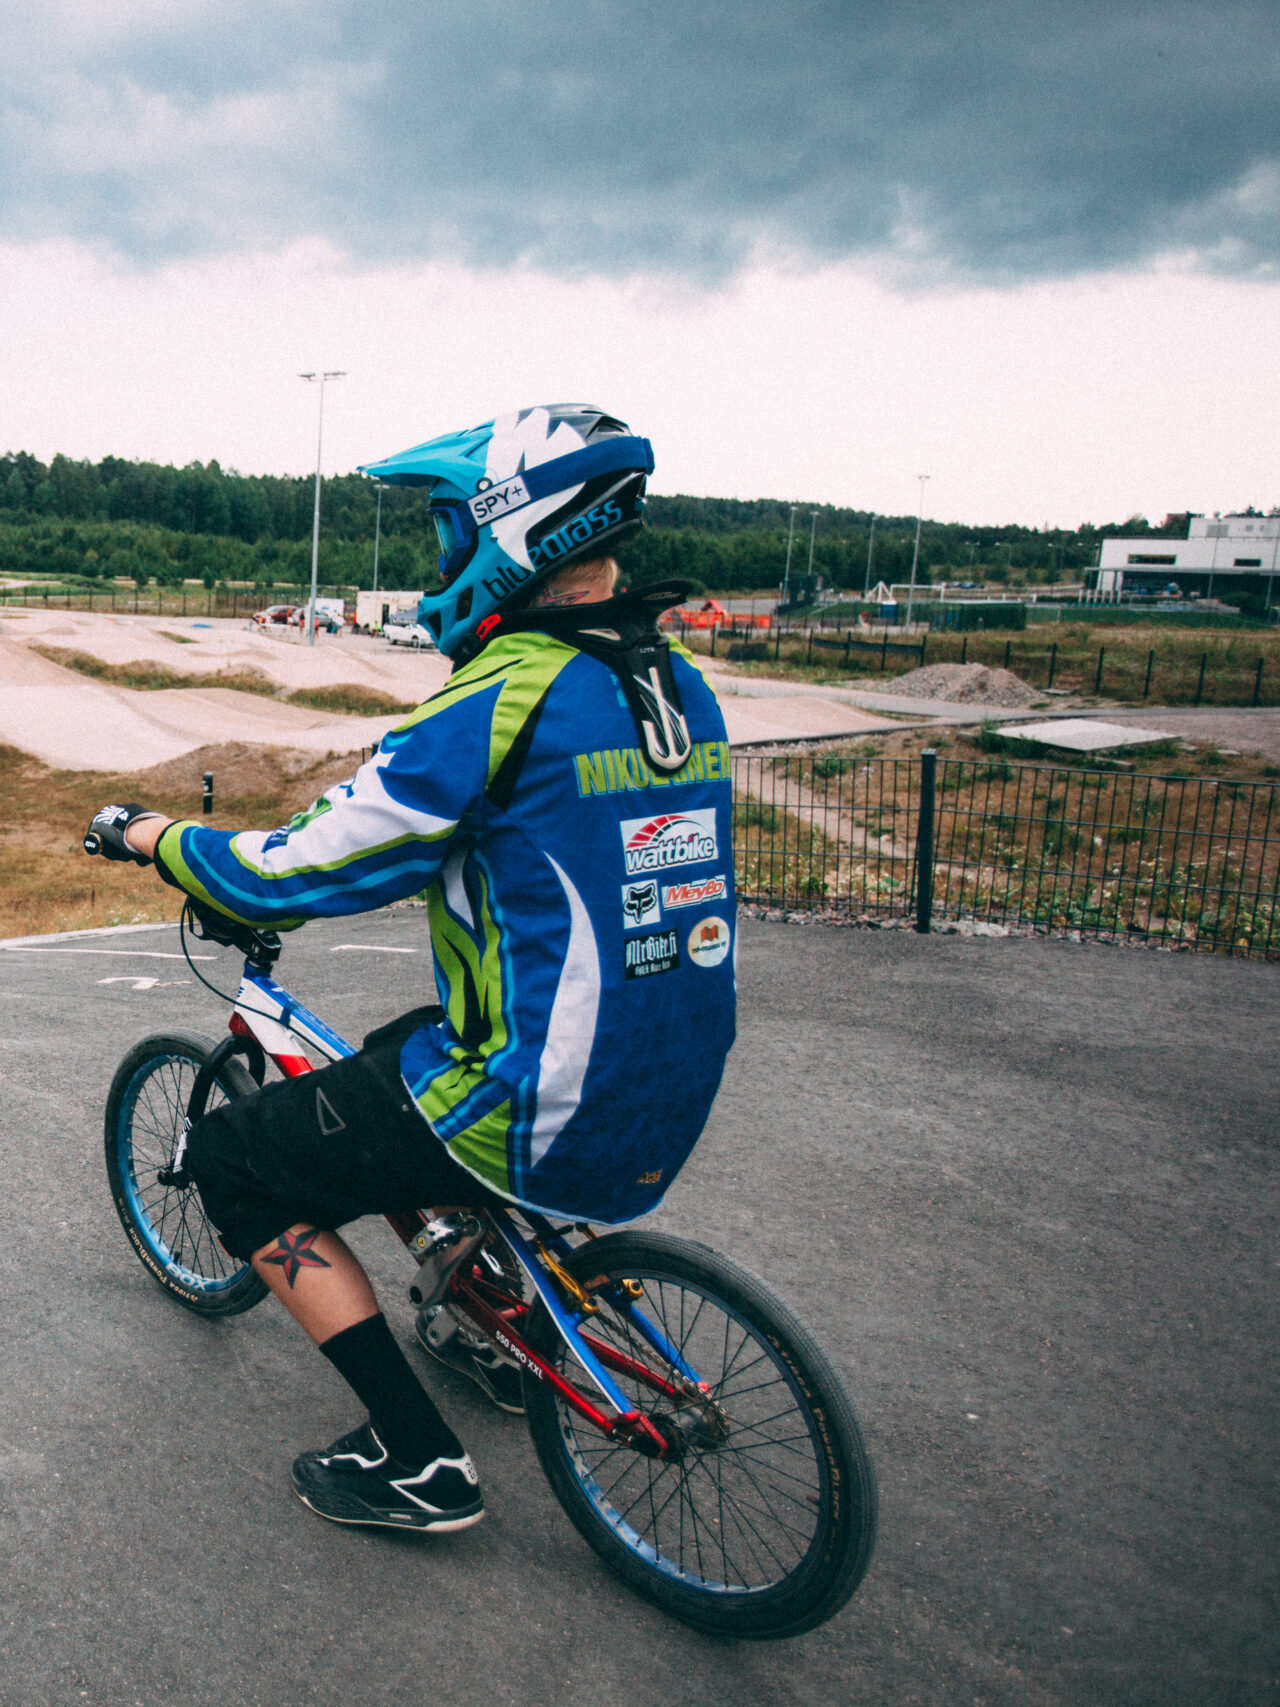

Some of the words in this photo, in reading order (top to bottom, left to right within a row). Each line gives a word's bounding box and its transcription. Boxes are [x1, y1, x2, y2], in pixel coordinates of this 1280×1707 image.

[473, 486, 523, 519] SPY+
[574, 742, 731, 796] NIKULNEN
[625, 833, 716, 873] wattbike
[165, 1262, 208, 1291] BOX
[495, 1330, 510, 1348] 550
[510, 1343, 527, 1363] PRO
[527, 1359, 544, 1380] XXL
